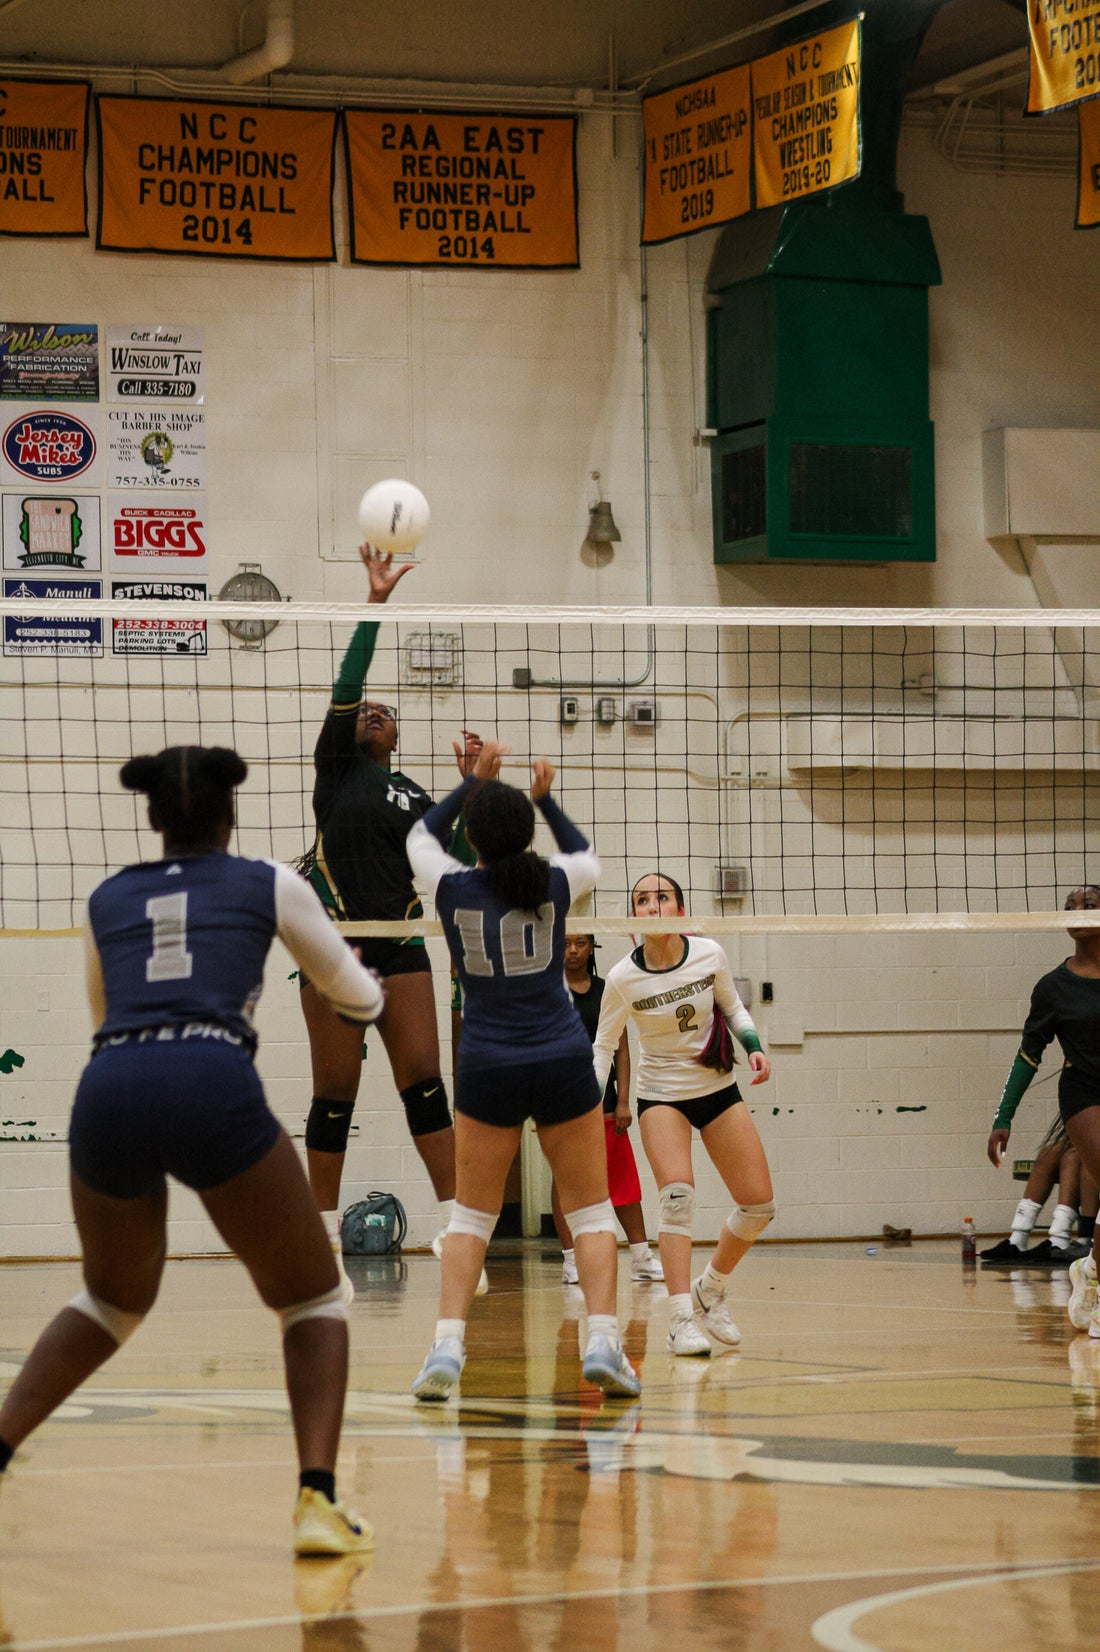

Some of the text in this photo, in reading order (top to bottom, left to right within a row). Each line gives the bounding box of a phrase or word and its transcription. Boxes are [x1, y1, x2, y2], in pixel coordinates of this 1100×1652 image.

[1075, 52, 1100, 88] 20
[675, 87, 716, 120] NCHSAA
[771, 97, 838, 142] CHAMPIONS
[382, 124, 544, 154] 2AA EAST
[663, 128, 692, 161] STATE
[697, 109, 748, 149] RUNNER-UP
[779, 127, 832, 170] WRESTLING
[138, 144, 297, 180] CHAMPIONS
[402, 154, 526, 180] REGIONAL
[660, 150, 734, 195] FOOTBALL
[783, 158, 831, 196] 2019-20
[139, 178, 296, 214] FOOTBALL
[394, 181, 536, 207] RUNNER-UP
[681, 189, 714, 223] 2019
[182, 215, 252, 246] 2014
[399, 208, 531, 234] FOOTBALL
[438, 236, 495, 258] 2014
[4, 325, 94, 354] Wilson
[130, 332, 182, 344] Call Today!
[3, 356, 94, 364] PERFORMANCE
[10, 364, 87, 372] FABRICATION
[112, 348, 201, 376] WINSLOW TAXI
[122, 382, 192, 396] Call 335-7180
[108, 412, 204, 423] CUT IN HIS IMAGE
[122, 422, 192, 432] BARBER SHOP
[16, 424, 82, 450] Jersey
[20, 444, 82, 465] Mike's
[38, 467, 62, 475] SUBS
[116, 476, 200, 488] 757-335-0755
[114, 520, 206, 556] BIGGS
[46, 588, 92, 598] Manuli
[114, 584, 204, 600] STEVENSON
[116, 622, 204, 630] 252-338-3004
[9, 646, 38, 654] Steven
[50, 646, 80, 655] Manuli,
[84, 646, 98, 654] MD
[146, 891, 193, 983] 1
[453, 901, 555, 978] 10
[676, 1004, 698, 1032] 2
